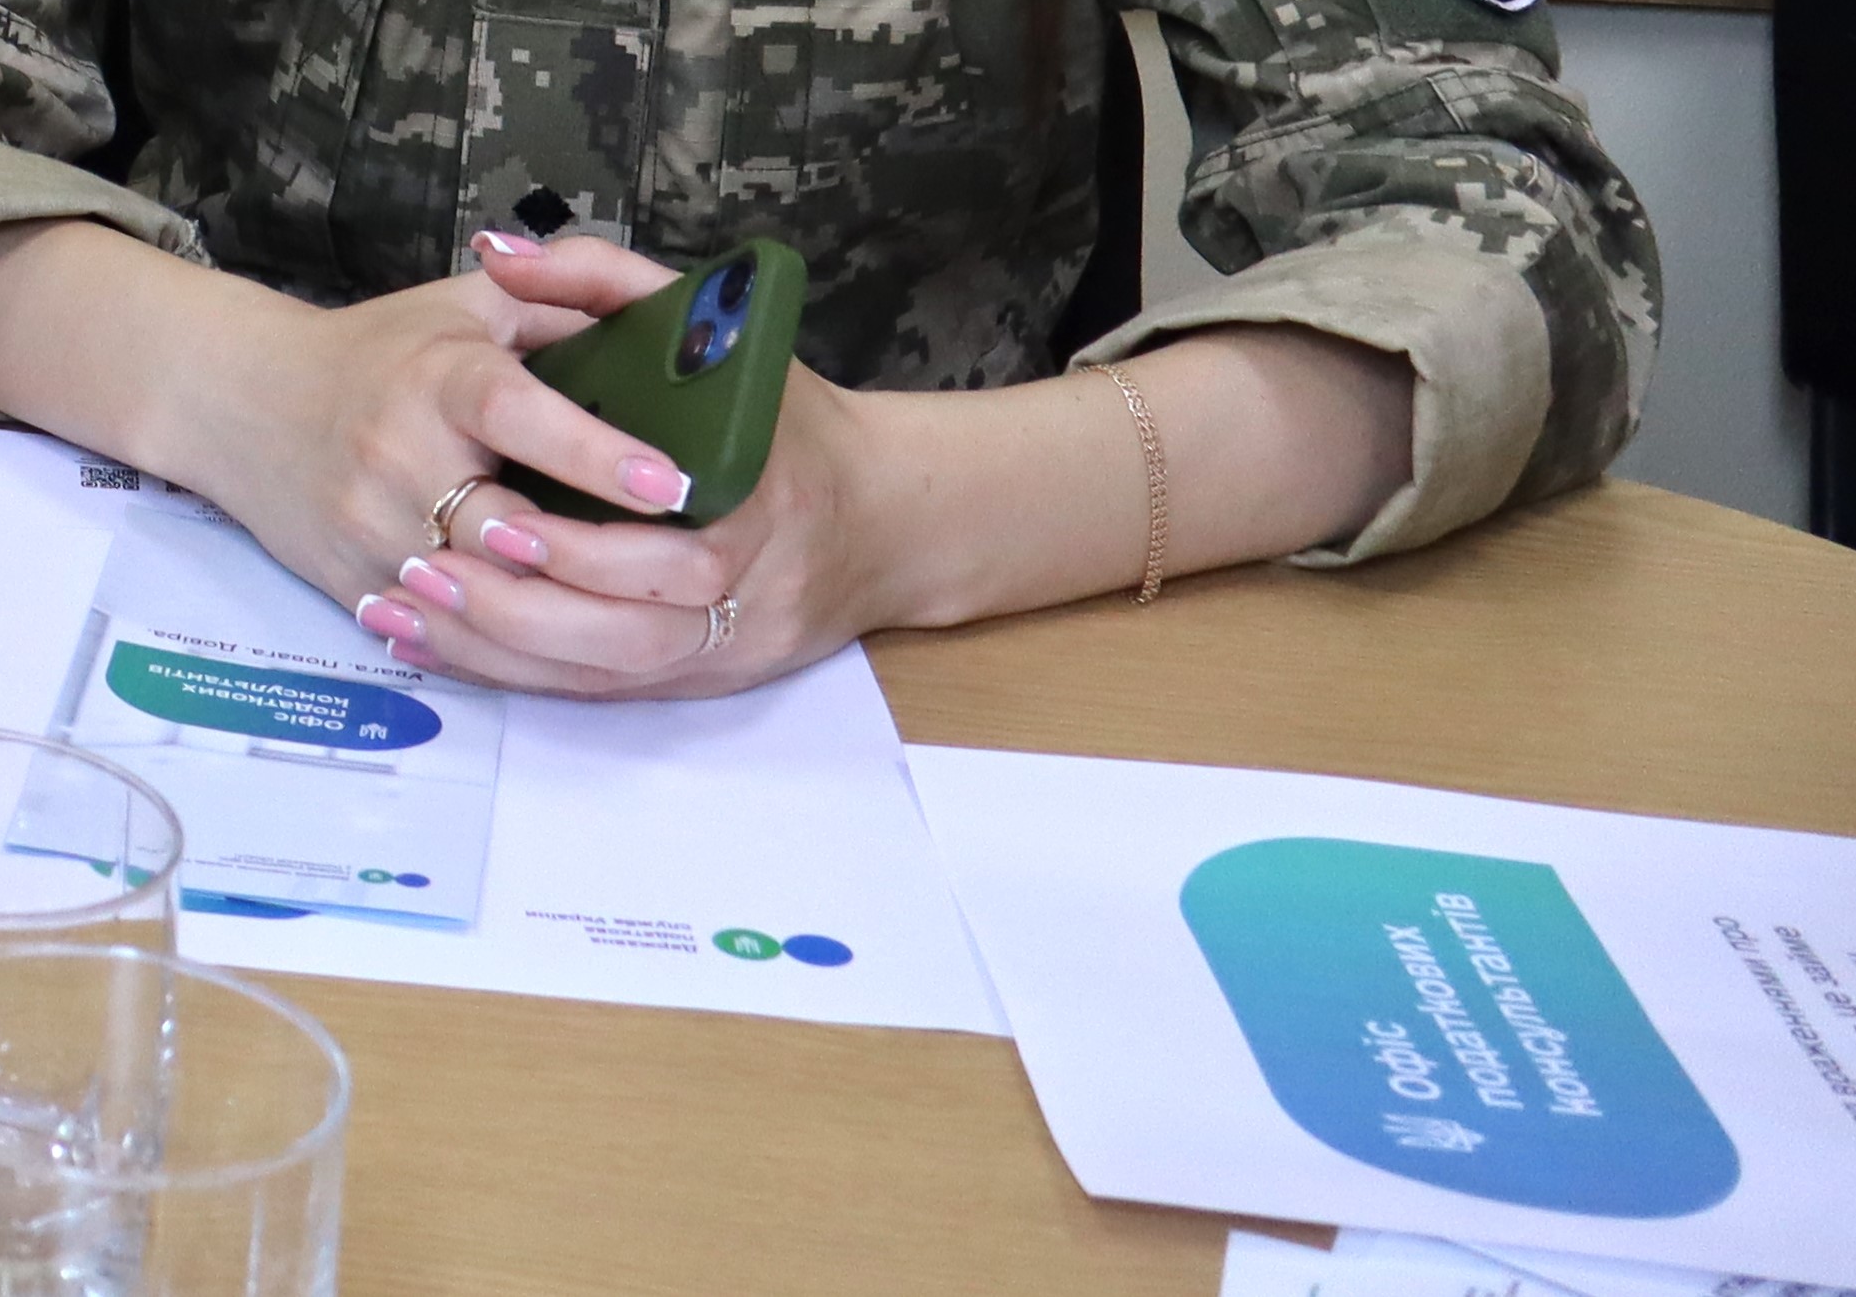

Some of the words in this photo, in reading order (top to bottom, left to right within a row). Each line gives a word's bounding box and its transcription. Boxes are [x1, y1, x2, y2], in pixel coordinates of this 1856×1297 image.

[148, 629, 237, 653] Довіра.
[246, 646, 338, 669] Повага.
[148, 663, 350, 709] консультантів
[181, 682, 347, 718] податкових
[274, 711, 346, 731] Офіс
[1712, 916, 1760, 954] про
[1383, 922, 1525, 1110] податкових
[1431, 892, 1604, 1117] консультантів
[1362, 1020, 1442, 1100] Офіс
